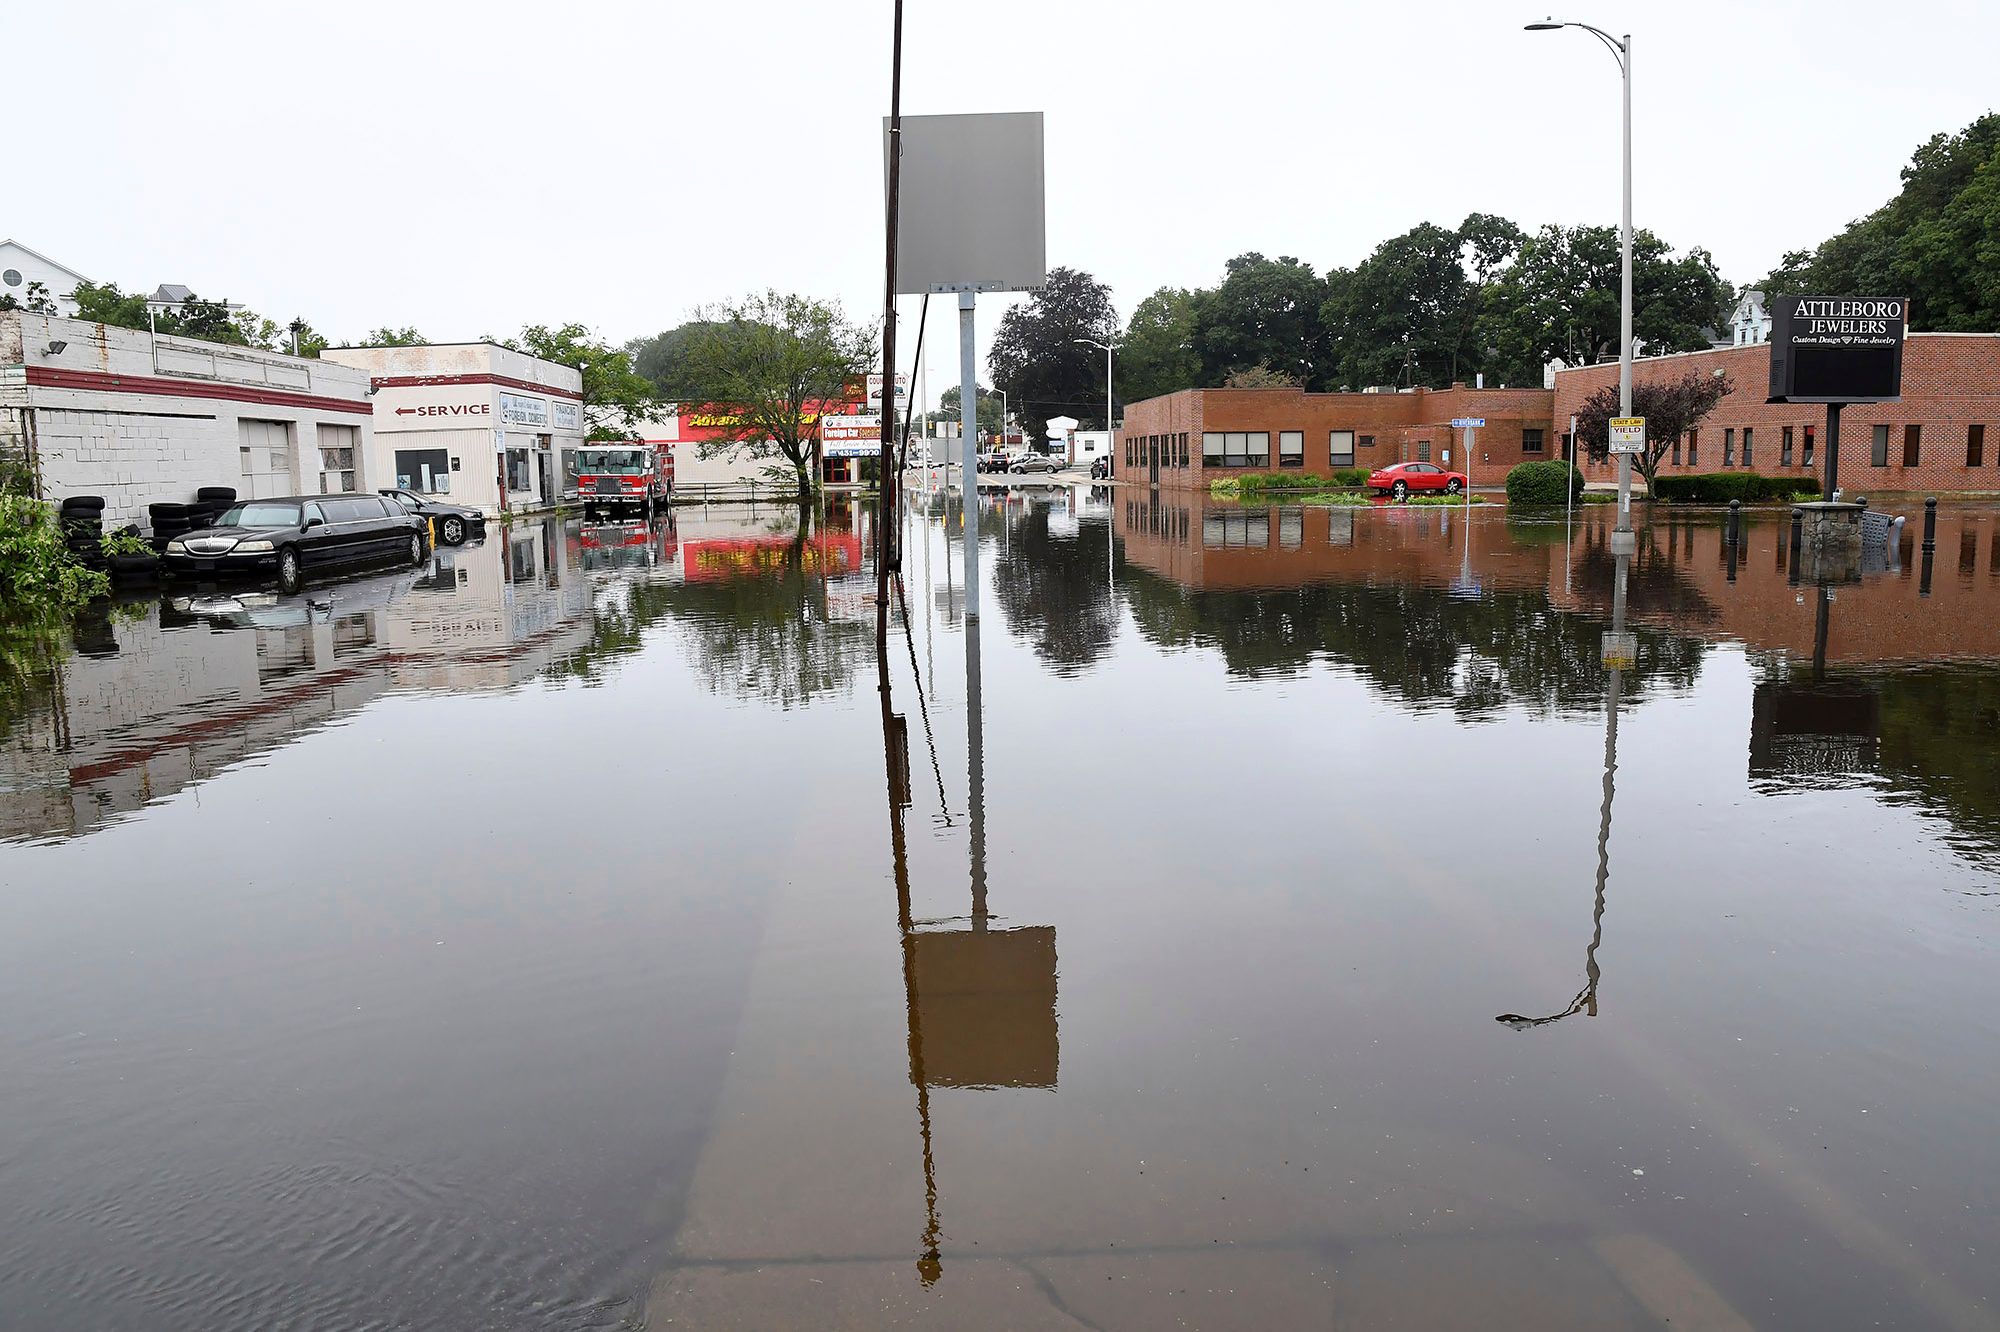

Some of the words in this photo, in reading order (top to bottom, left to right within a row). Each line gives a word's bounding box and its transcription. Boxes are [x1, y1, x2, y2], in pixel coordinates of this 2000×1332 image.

[1794, 299, 1901, 317] ATTLEBORO
[1809, 320, 1887, 334] JEWELERS
[1792, 335, 1817, 344] Custom
[1818, 335, 1841, 344] Design
[1853, 336, 1868, 344] Fine
[1870, 336, 1897, 346] Jewelry
[417, 404, 490, 416] SERVICE
[688, 414, 750, 427] Advanc
[825, 428, 848, 439] Foreign
[848, 428, 859, 438] Car
